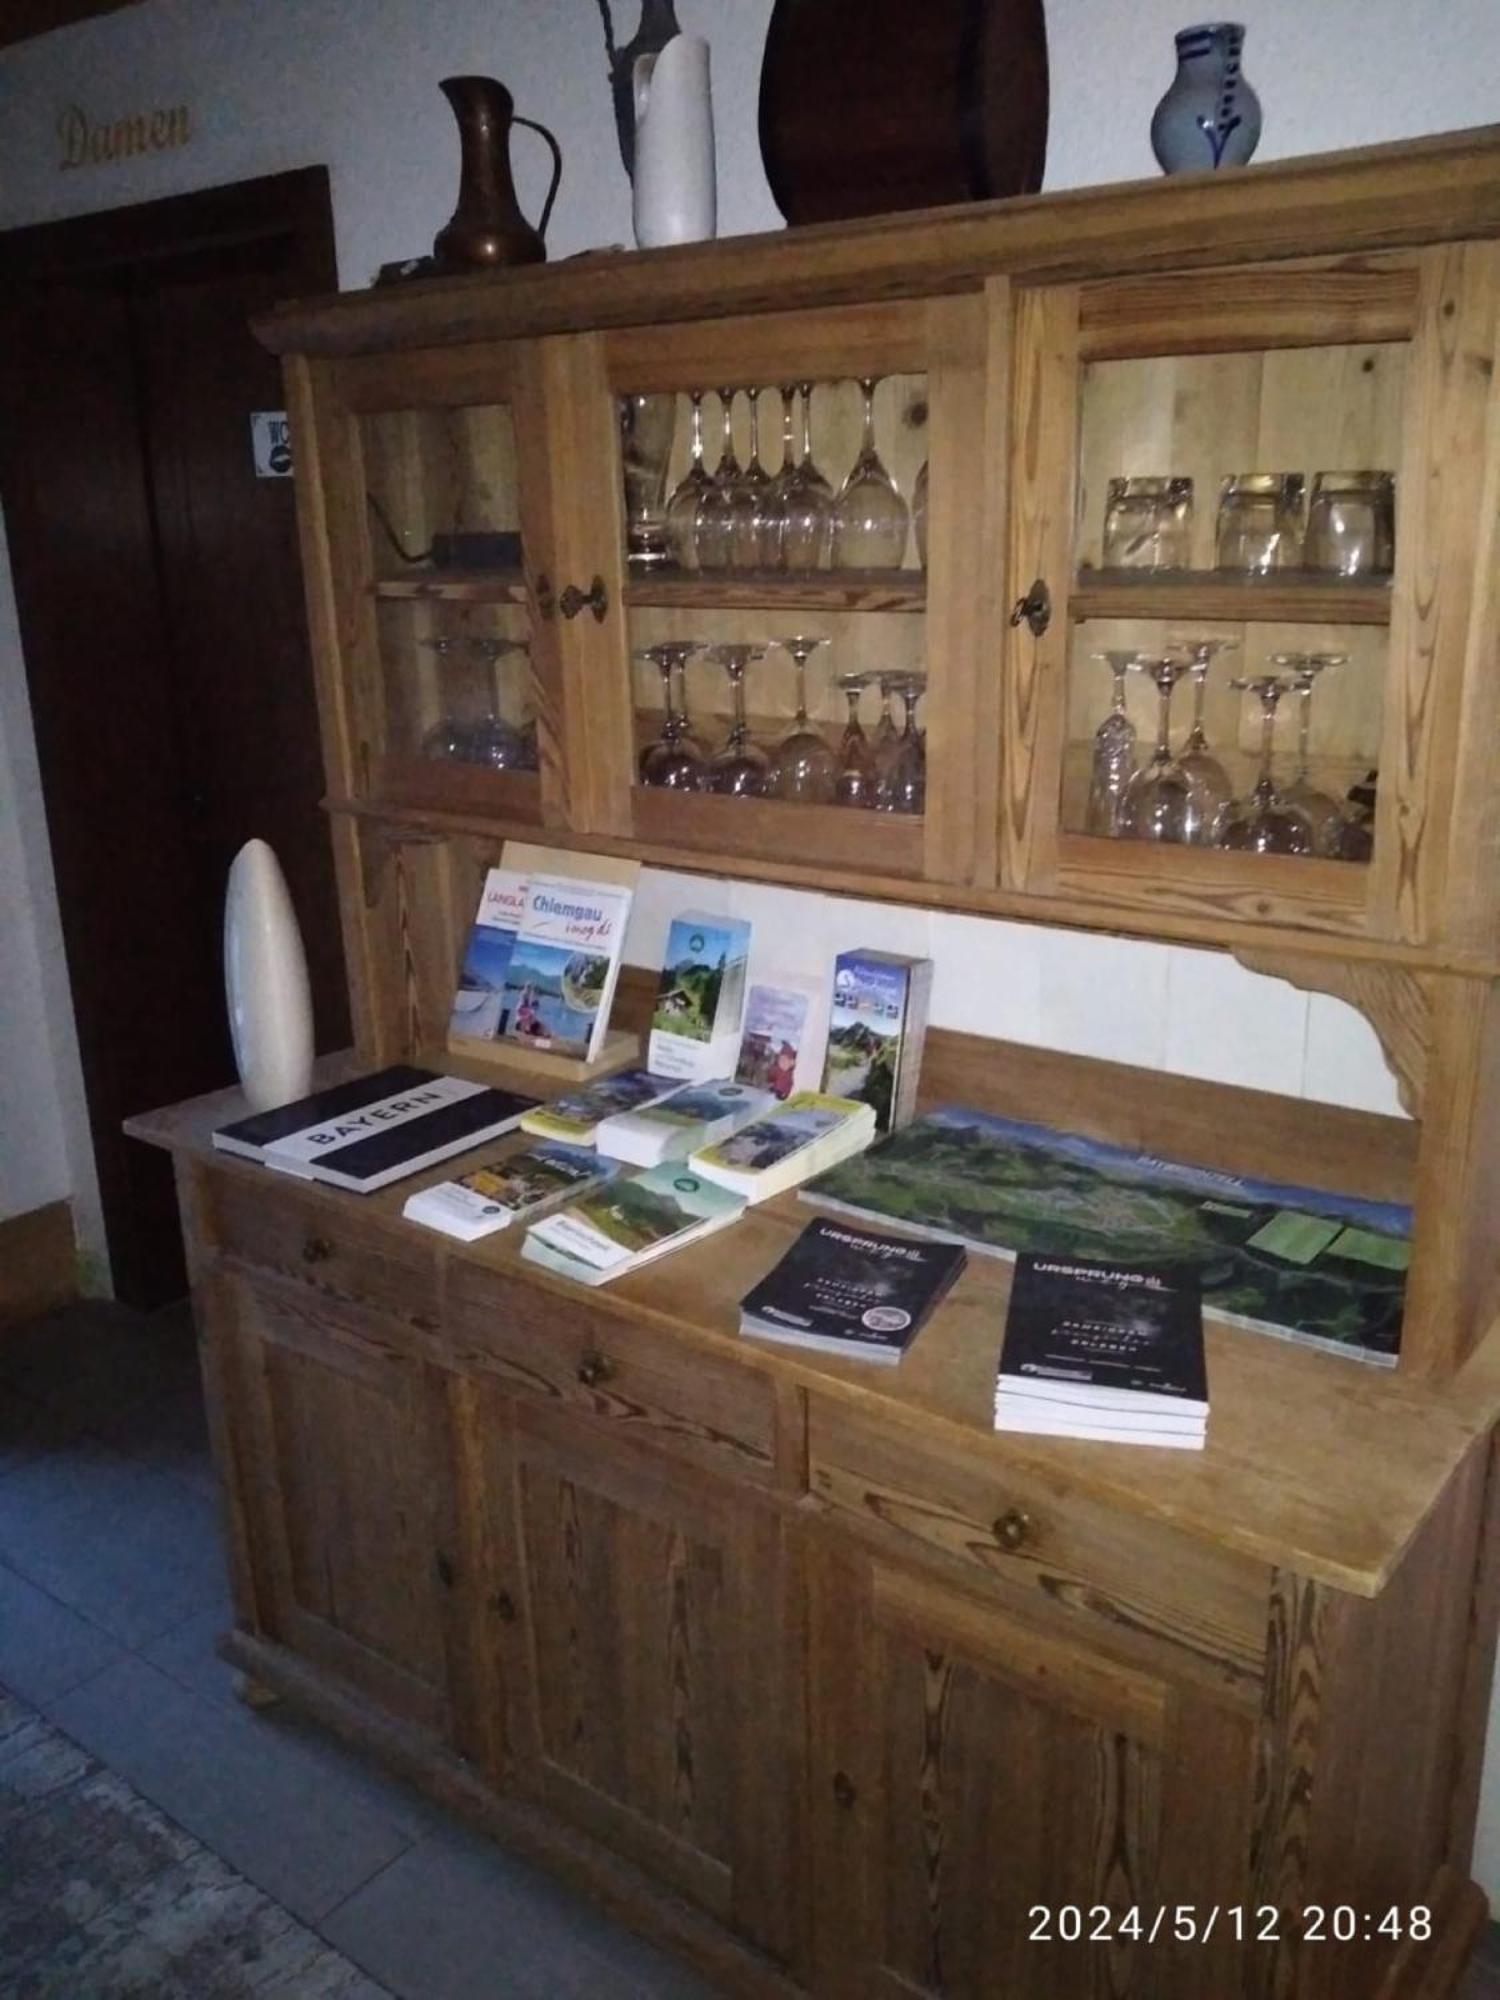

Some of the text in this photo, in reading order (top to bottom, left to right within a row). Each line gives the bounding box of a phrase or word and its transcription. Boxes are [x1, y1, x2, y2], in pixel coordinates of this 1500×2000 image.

[56, 103, 191, 170] Damen
[533, 894, 603, 922] Chiemgau
[307, 1091, 443, 1145] BAYERN
[819, 1227, 907, 1256] URSPRUNG
[1033, 1261, 1145, 1283] URSPRUNG
